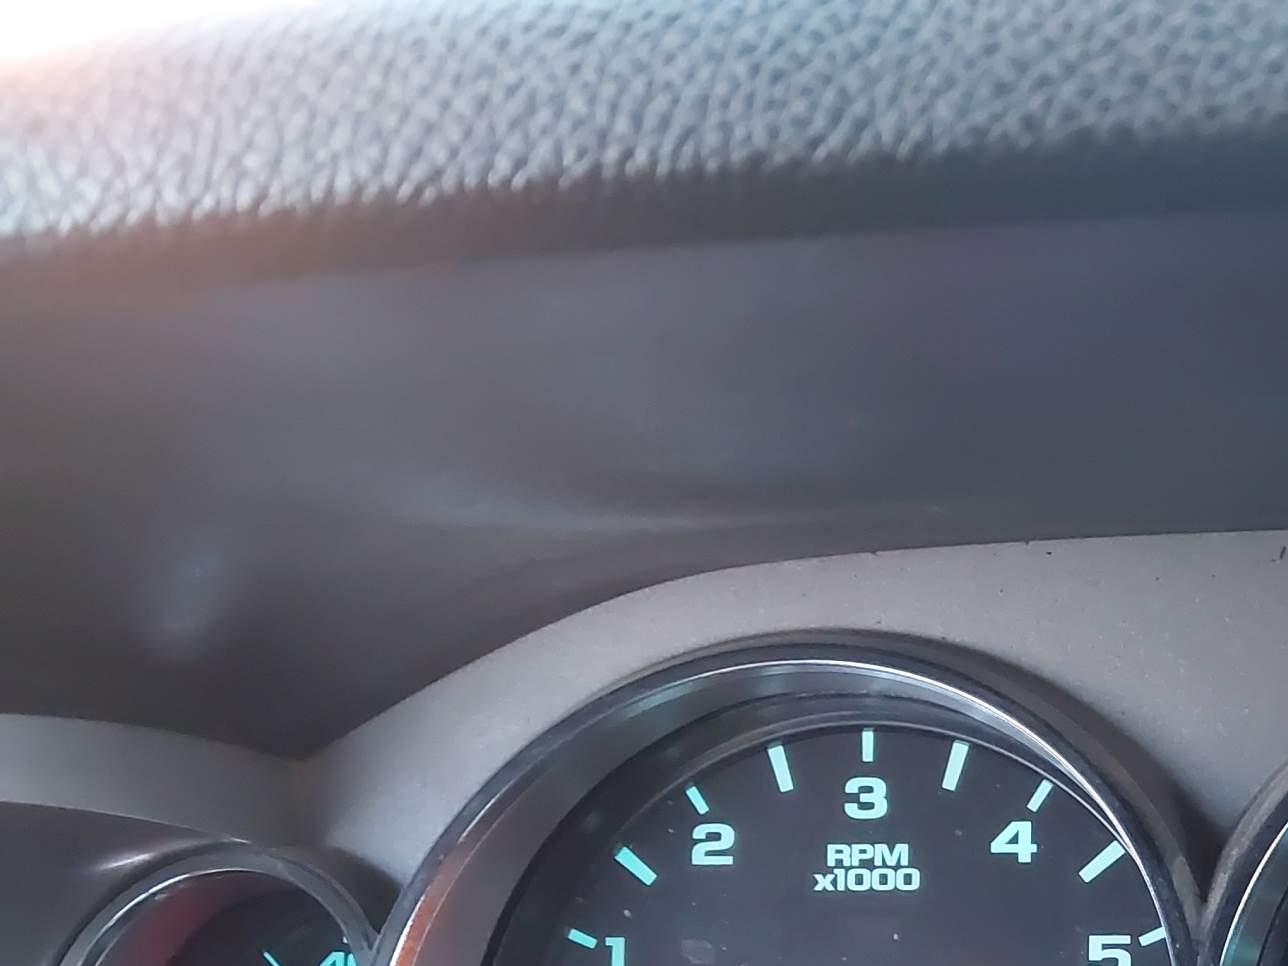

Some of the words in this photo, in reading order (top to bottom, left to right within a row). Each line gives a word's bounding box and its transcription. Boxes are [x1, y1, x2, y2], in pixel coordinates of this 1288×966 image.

[845, 777, 887, 819] 3
[692, 824, 734, 865] 2
[826, 843, 909, 866] RPM
[991, 821, 1037, 862] 4
[813, 868, 921, 891] x1000
